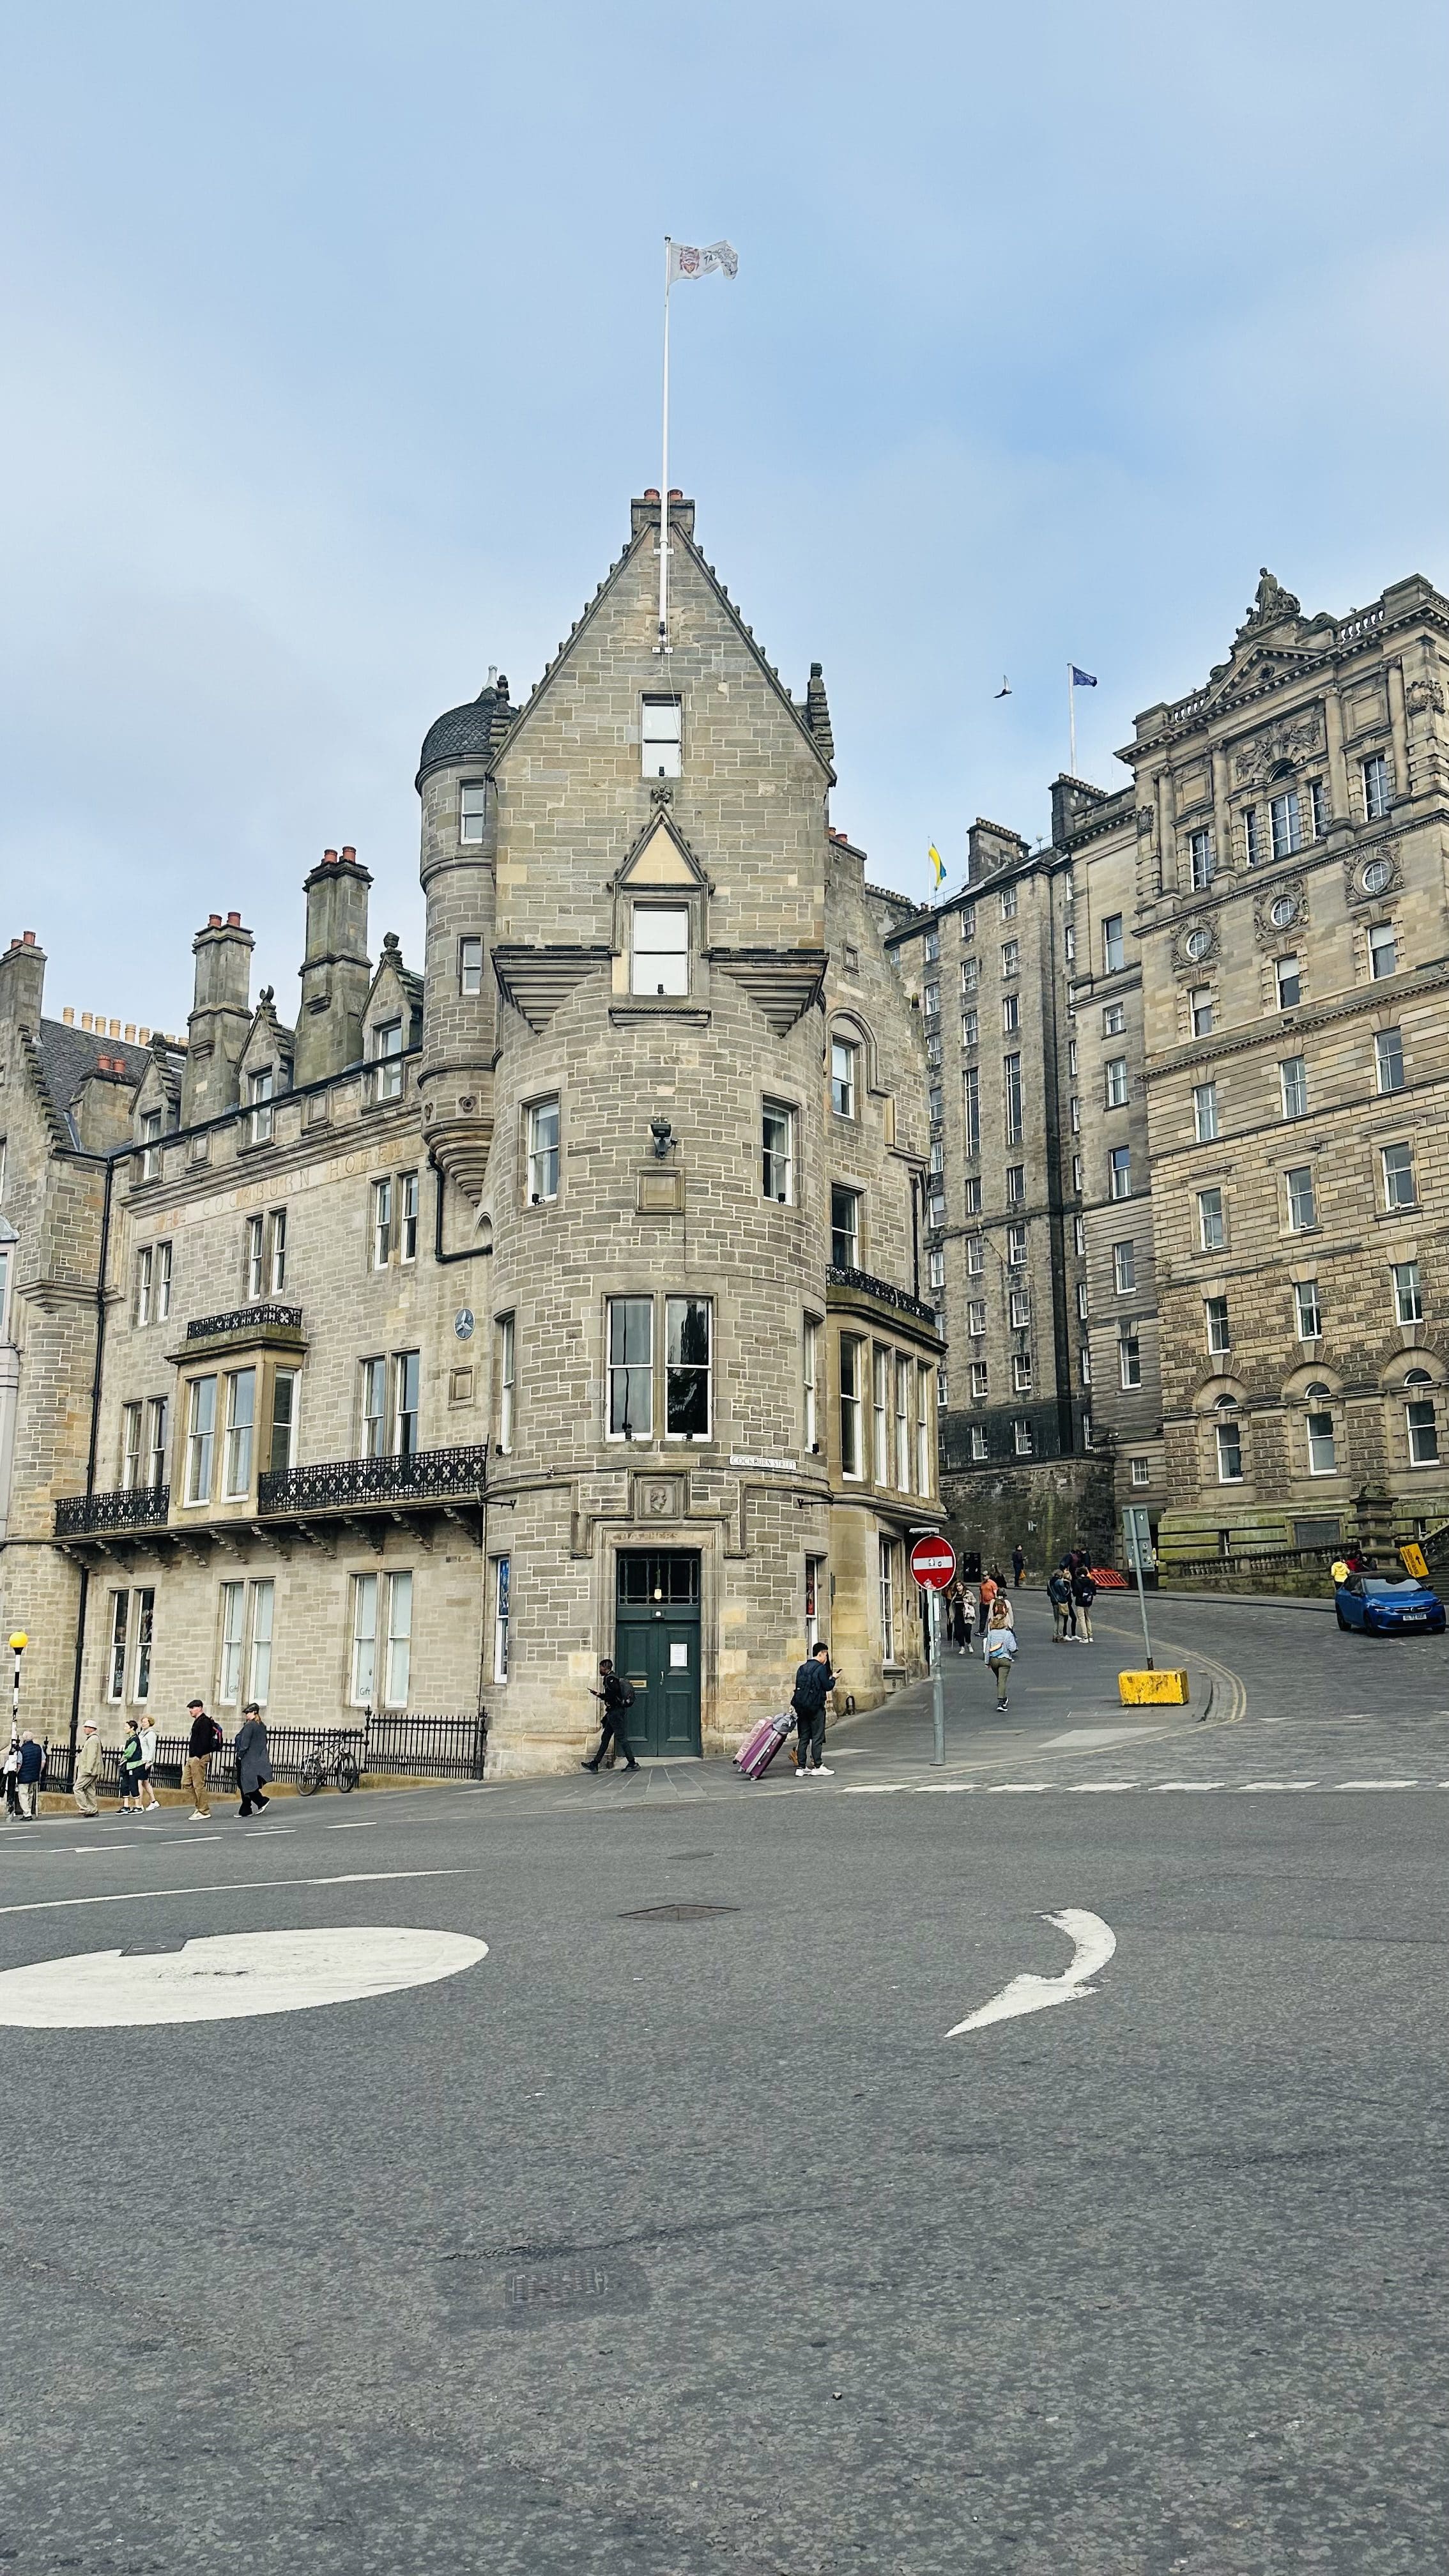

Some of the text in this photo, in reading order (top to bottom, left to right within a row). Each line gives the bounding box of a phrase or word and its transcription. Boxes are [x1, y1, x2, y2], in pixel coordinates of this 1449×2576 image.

[202, 1167, 310, 1216] COCKBURN
[329, 1141, 402, 1179] HOTEL
[732, 1457, 794, 1469] COCKBURN STREET
